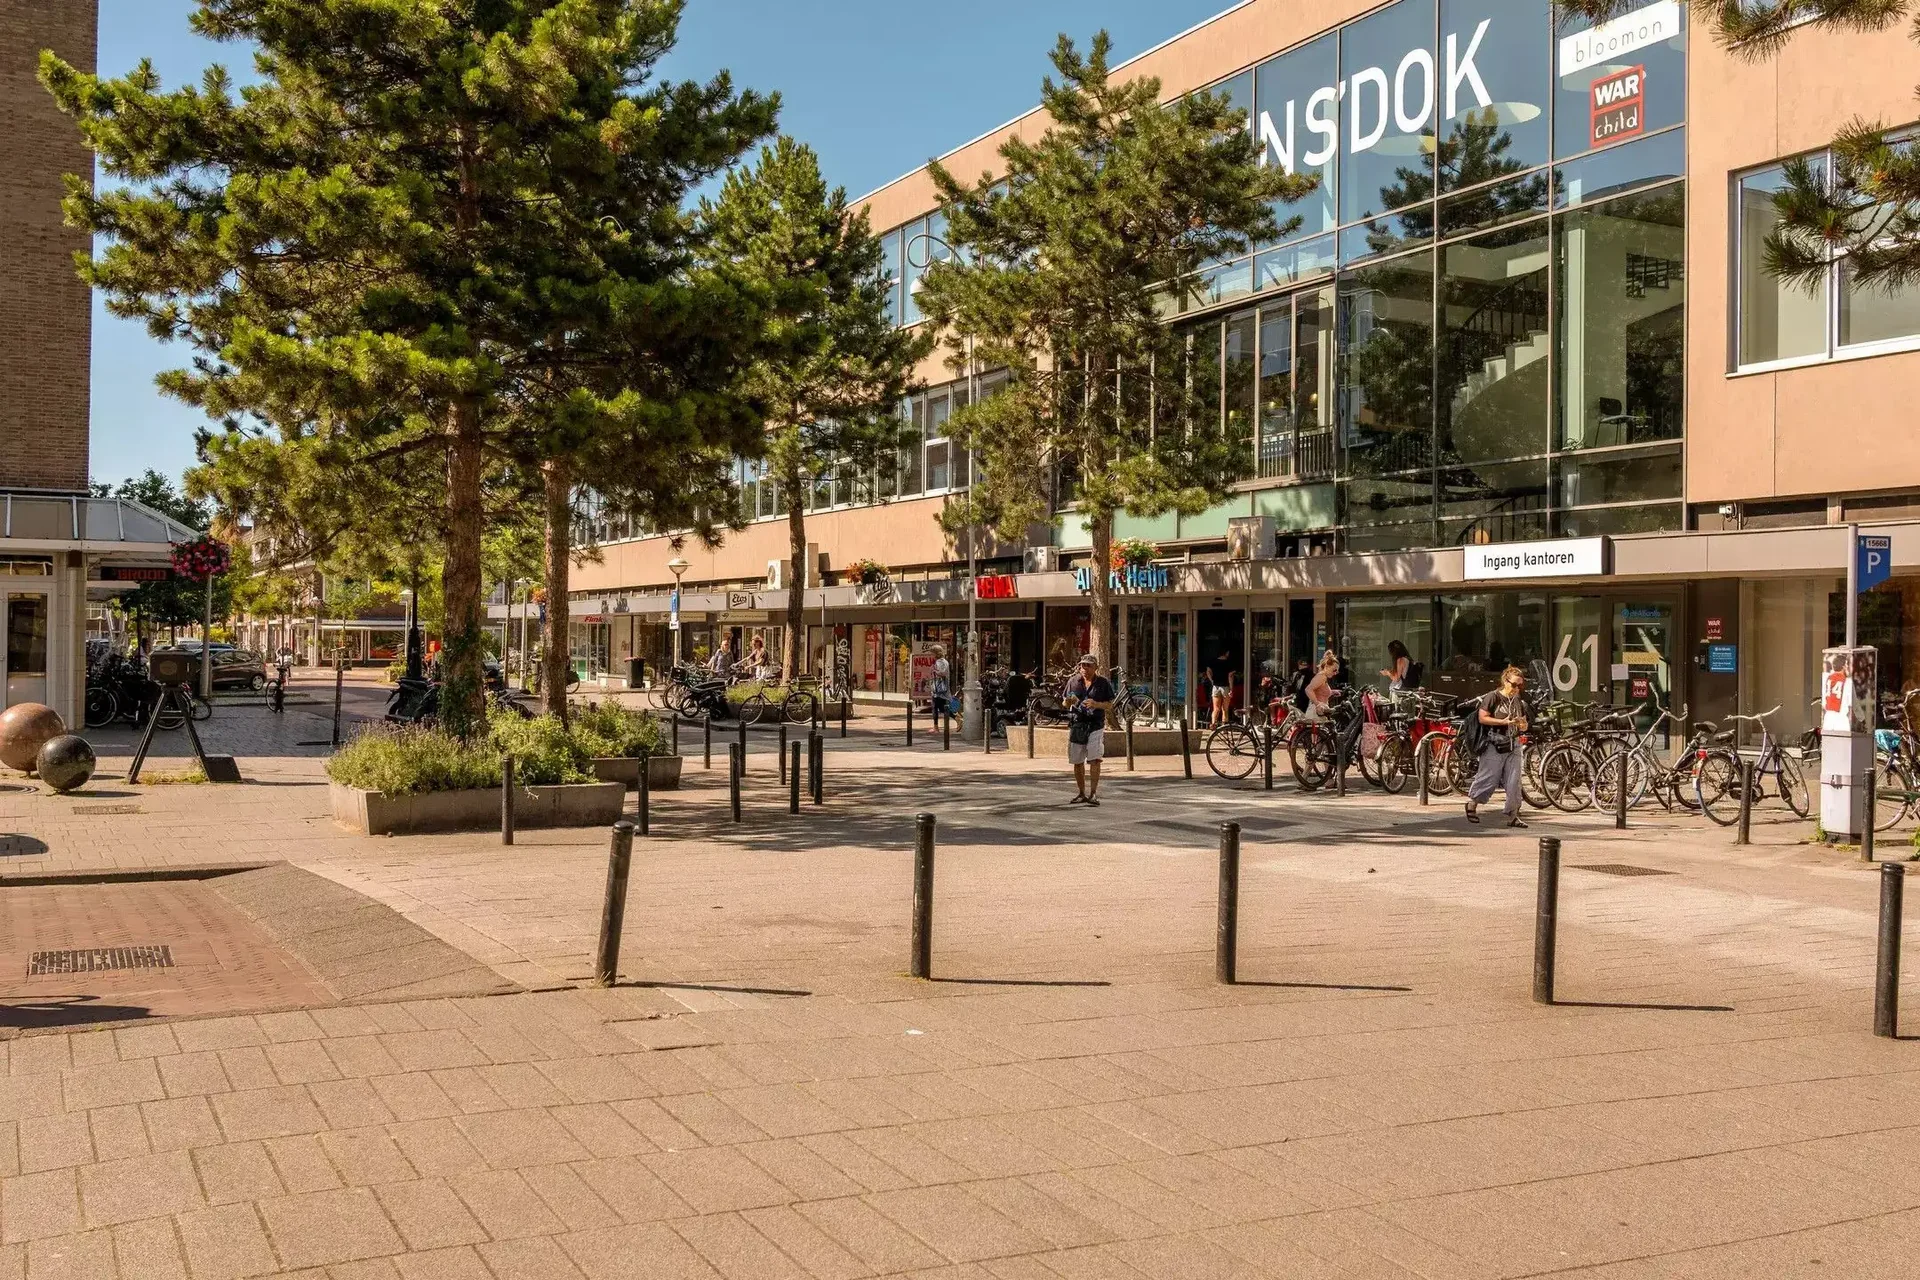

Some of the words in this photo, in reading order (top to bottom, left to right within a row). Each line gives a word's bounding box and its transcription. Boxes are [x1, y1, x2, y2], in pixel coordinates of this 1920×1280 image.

[1575, 20, 1663, 63] bloomon
[1246, 19, 1492, 176] NSDOK
[1593, 74, 1640, 107] WAR
[1594, 107, 1638, 139] child
[118, 569, 167, 580] BROOD
[1483, 554, 1520, 570] Ingang
[1523, 552, 1575, 566] kantoren
[1867, 551, 1882, 574] P
[1126, 564, 1168, 593] Heijn
[731, 593, 747, 605] Etos
[1553, 634, 1599, 692] 61
[1826, 680, 1844, 699] 14
